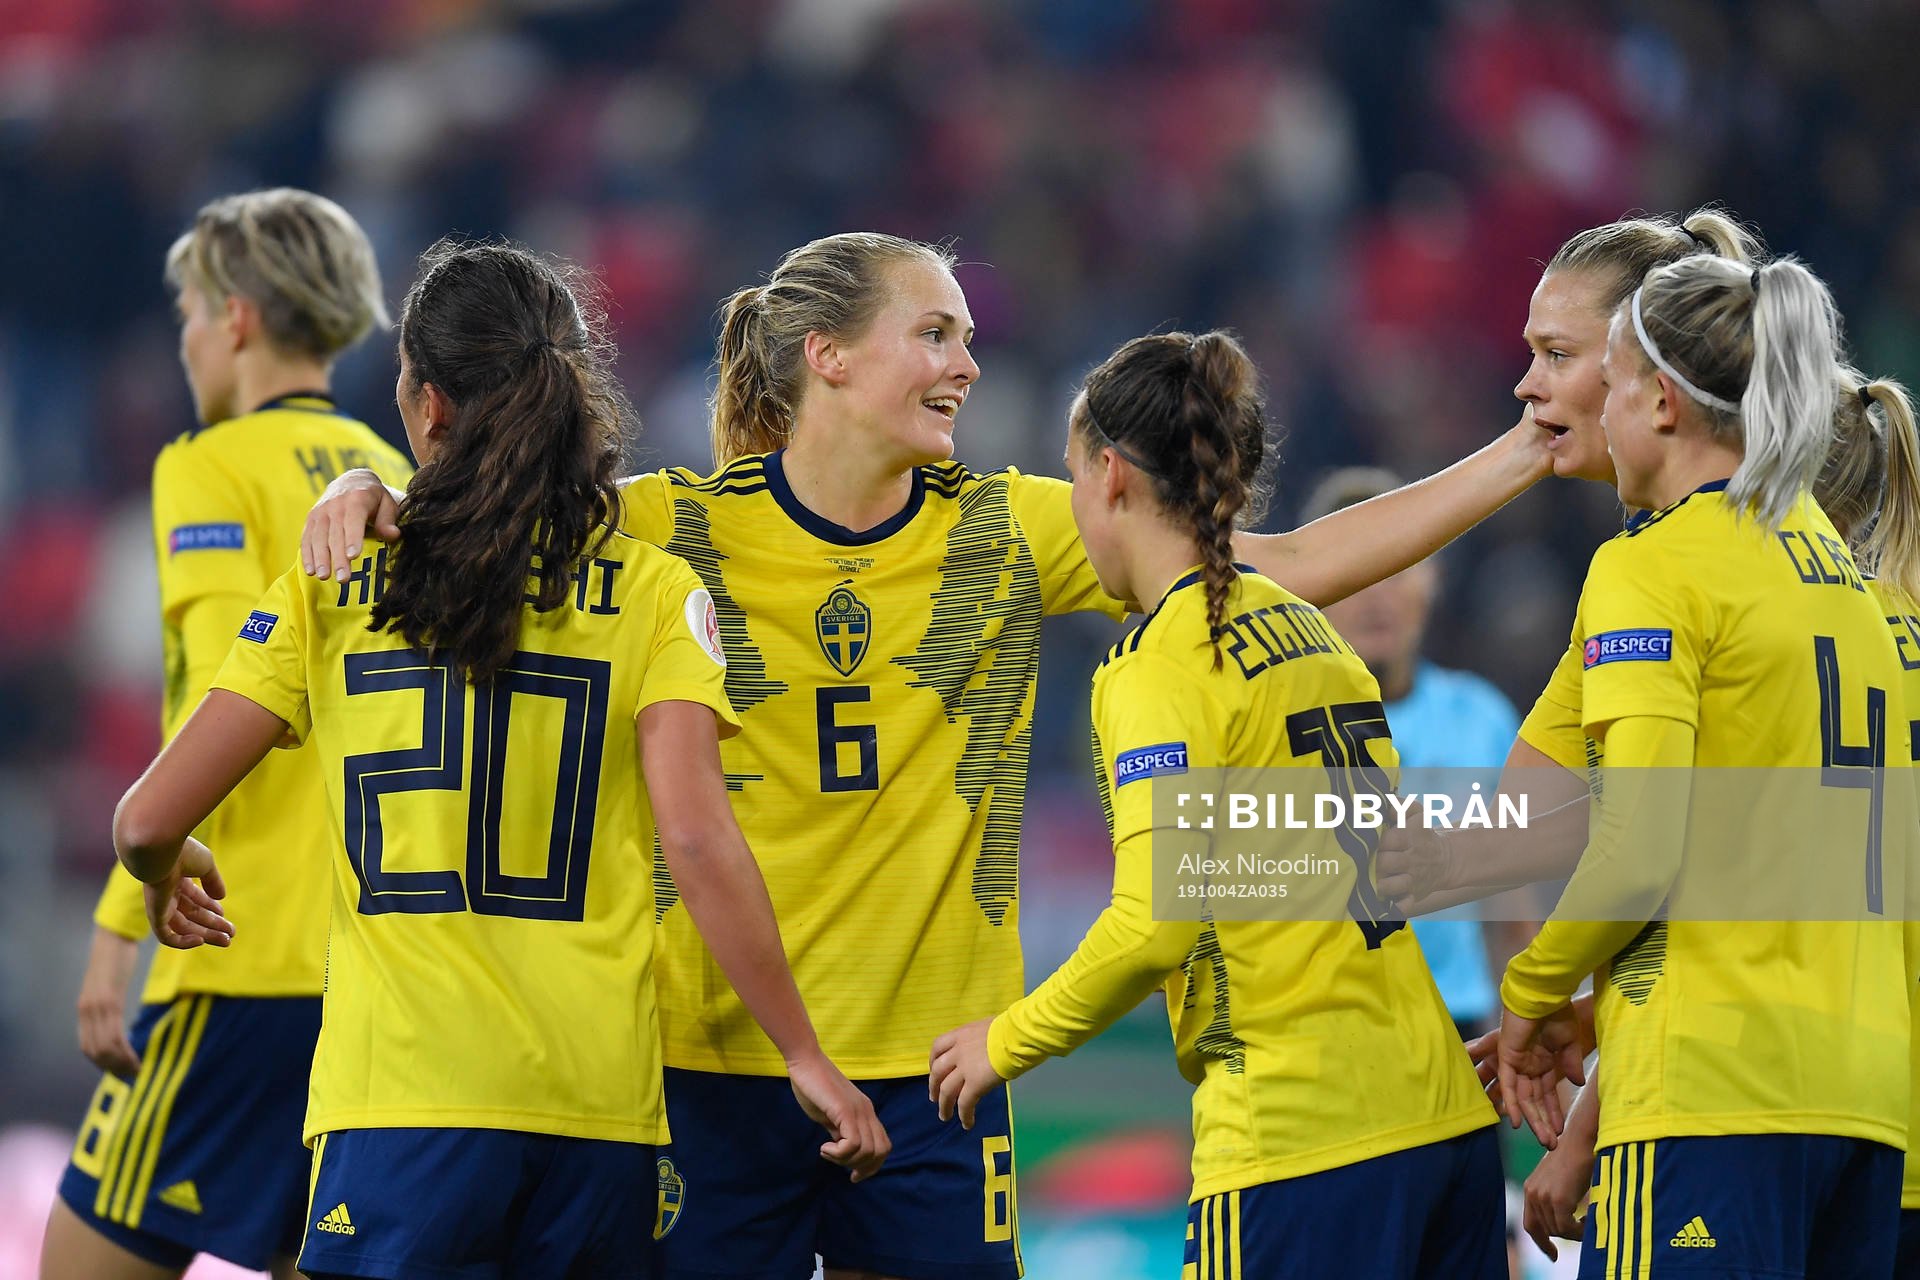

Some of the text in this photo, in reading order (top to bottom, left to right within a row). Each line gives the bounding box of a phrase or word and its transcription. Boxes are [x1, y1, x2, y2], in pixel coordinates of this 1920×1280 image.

[826, 615, 861, 623] SVERIGE
[1601, 637, 1671, 656] RESPECT
[816, 685, 879, 793] 6
[1118, 750, 1186, 777] RESPECT
[1814, 635, 1886, 915] 4
[344, 648, 611, 922] 20
[982, 1135, 1012, 1242] 6
[316, 1221, 356, 1236] adidas
[1670, 1236, 1717, 1248] adidas
